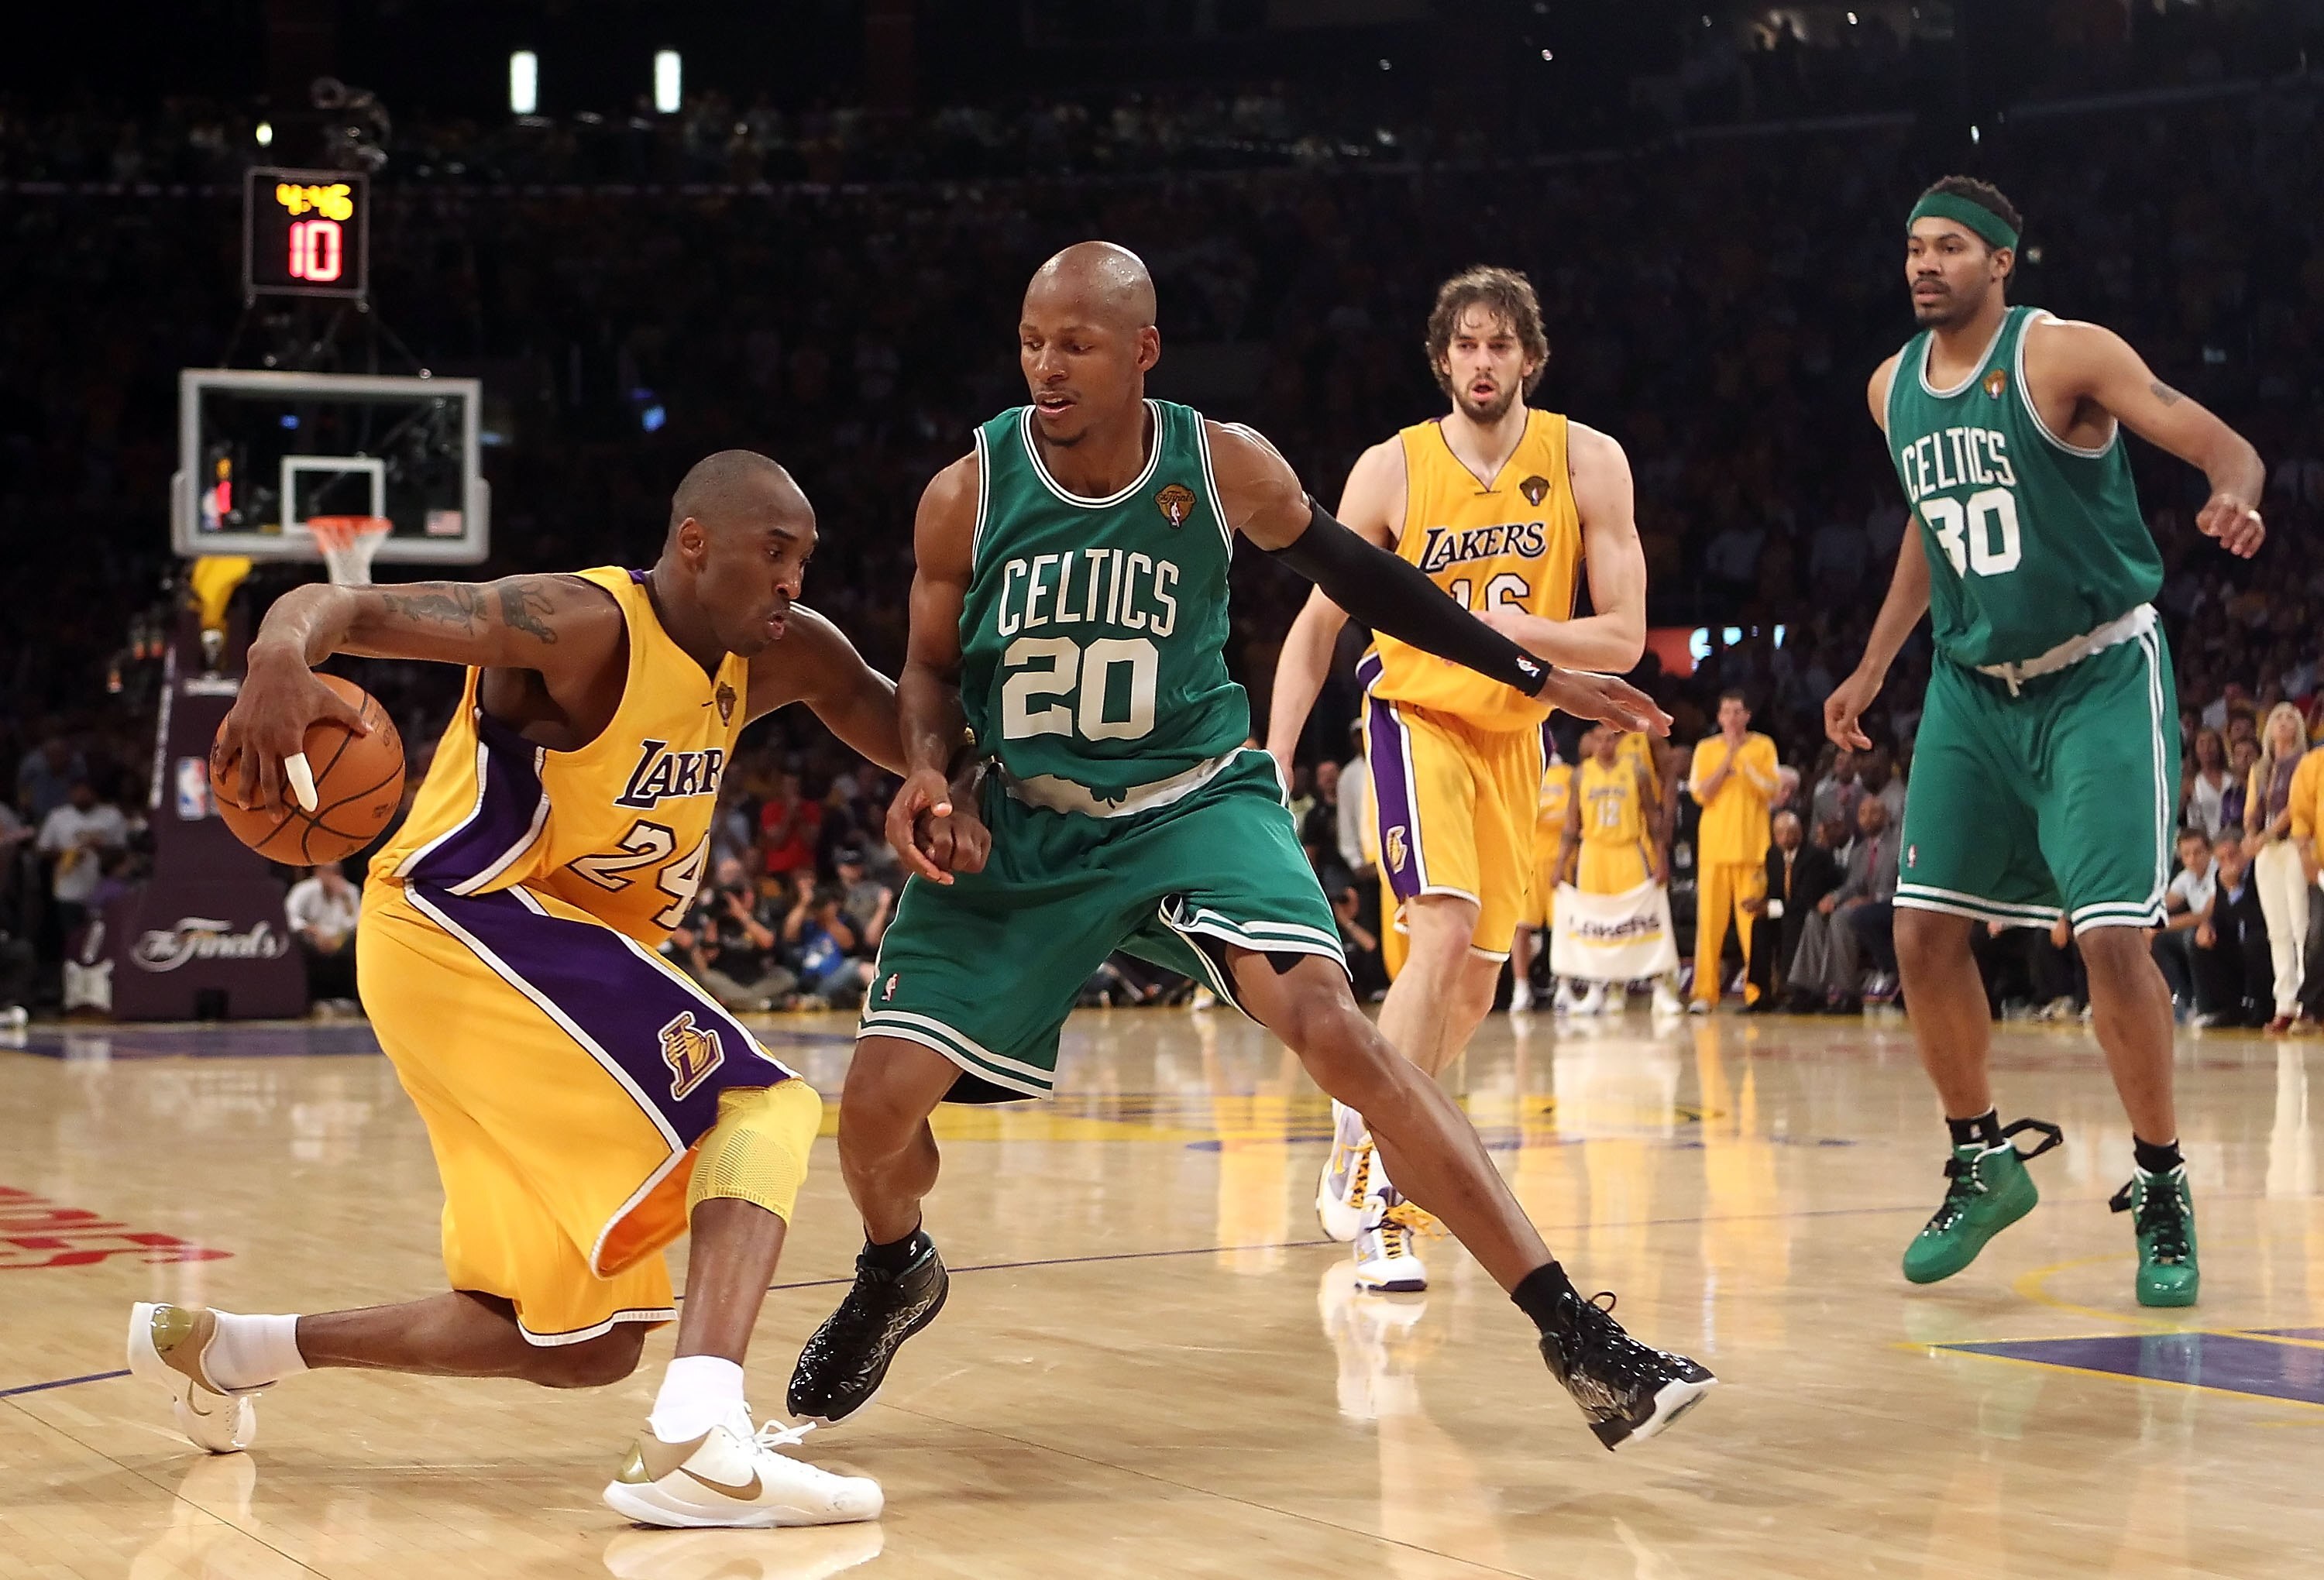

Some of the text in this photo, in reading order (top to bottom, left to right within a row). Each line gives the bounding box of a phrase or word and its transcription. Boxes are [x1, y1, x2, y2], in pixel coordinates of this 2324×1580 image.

[289, 219, 343, 282] 10
[1901, 426, 2017, 504] CELTICS
[1418, 521, 1546, 575] LAKERS
[998, 548, 1180, 637] CELTICS
[1001, 637, 1160, 742] 20
[566, 819, 711, 931] 24
